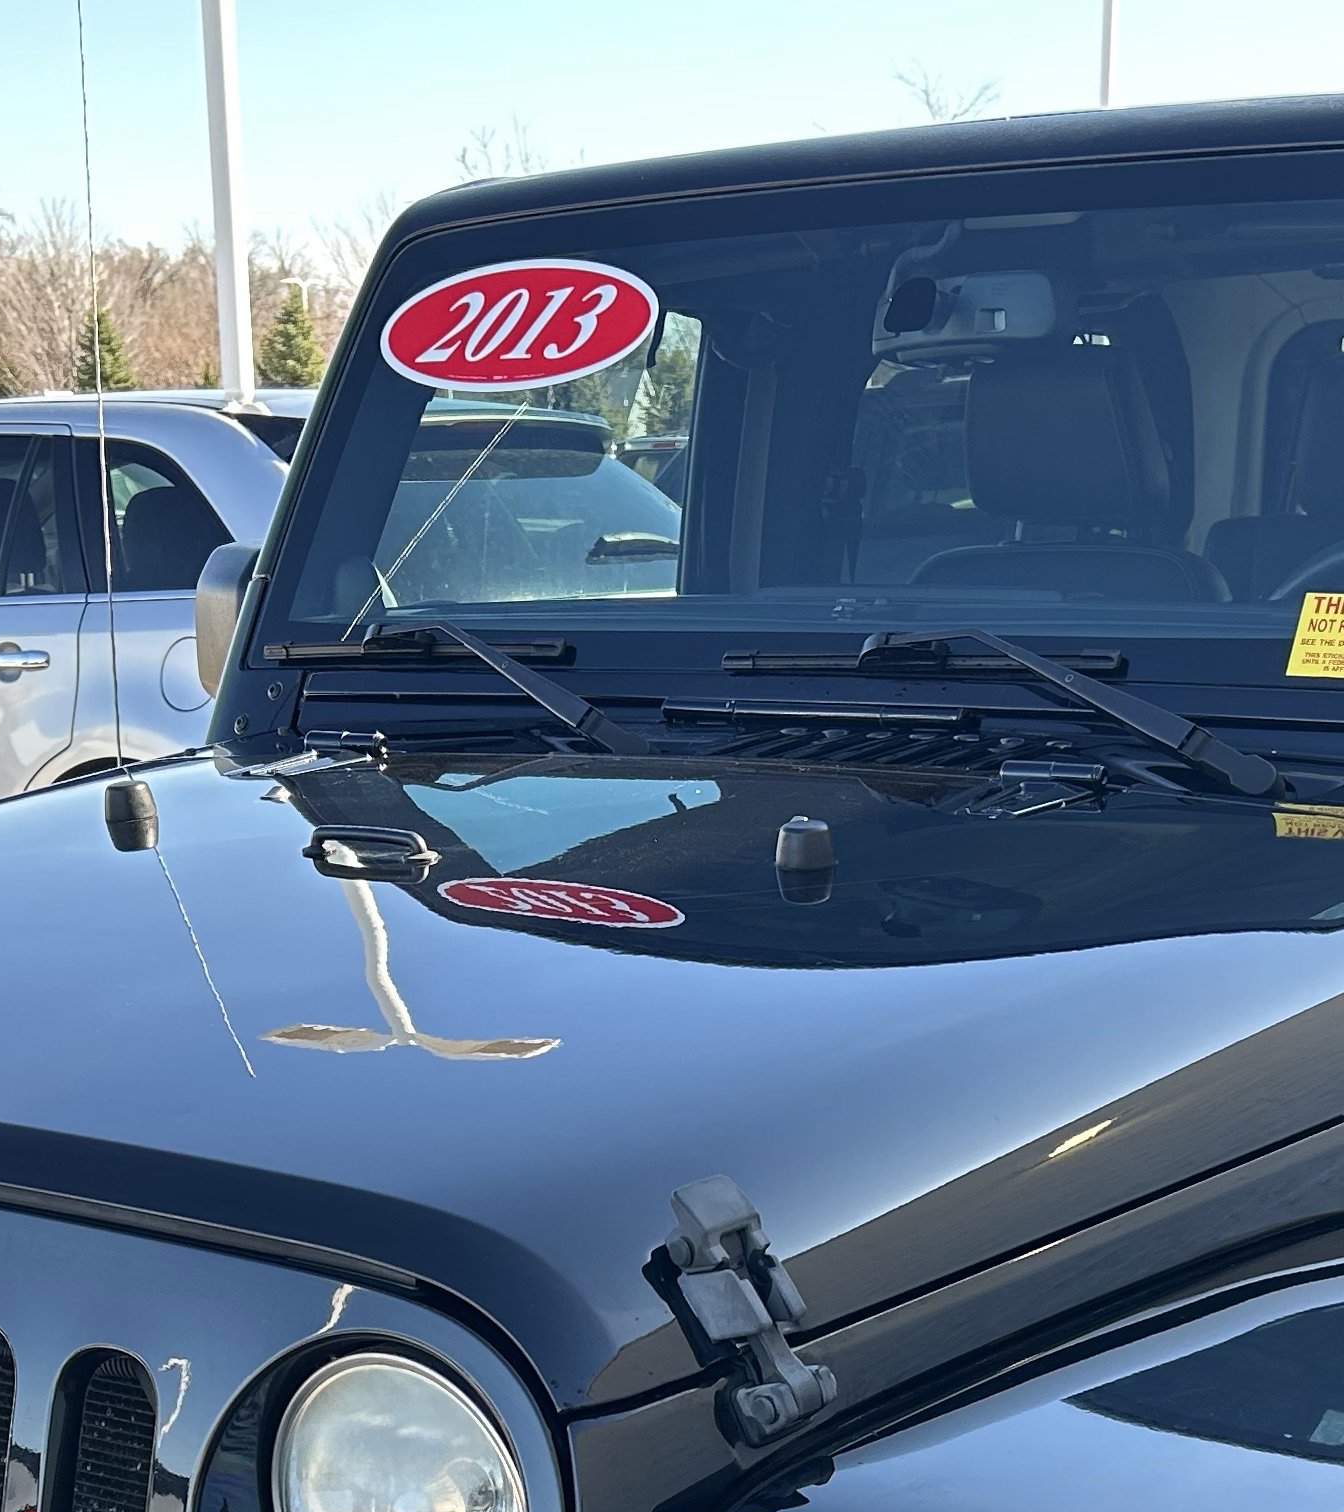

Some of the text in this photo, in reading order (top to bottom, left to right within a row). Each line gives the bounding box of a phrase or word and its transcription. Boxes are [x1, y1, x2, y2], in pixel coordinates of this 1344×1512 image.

[414, 283, 619, 364] 2013
[1308, 618, 1337, 633] NOT
[1320, 638, 1336, 646] THE
